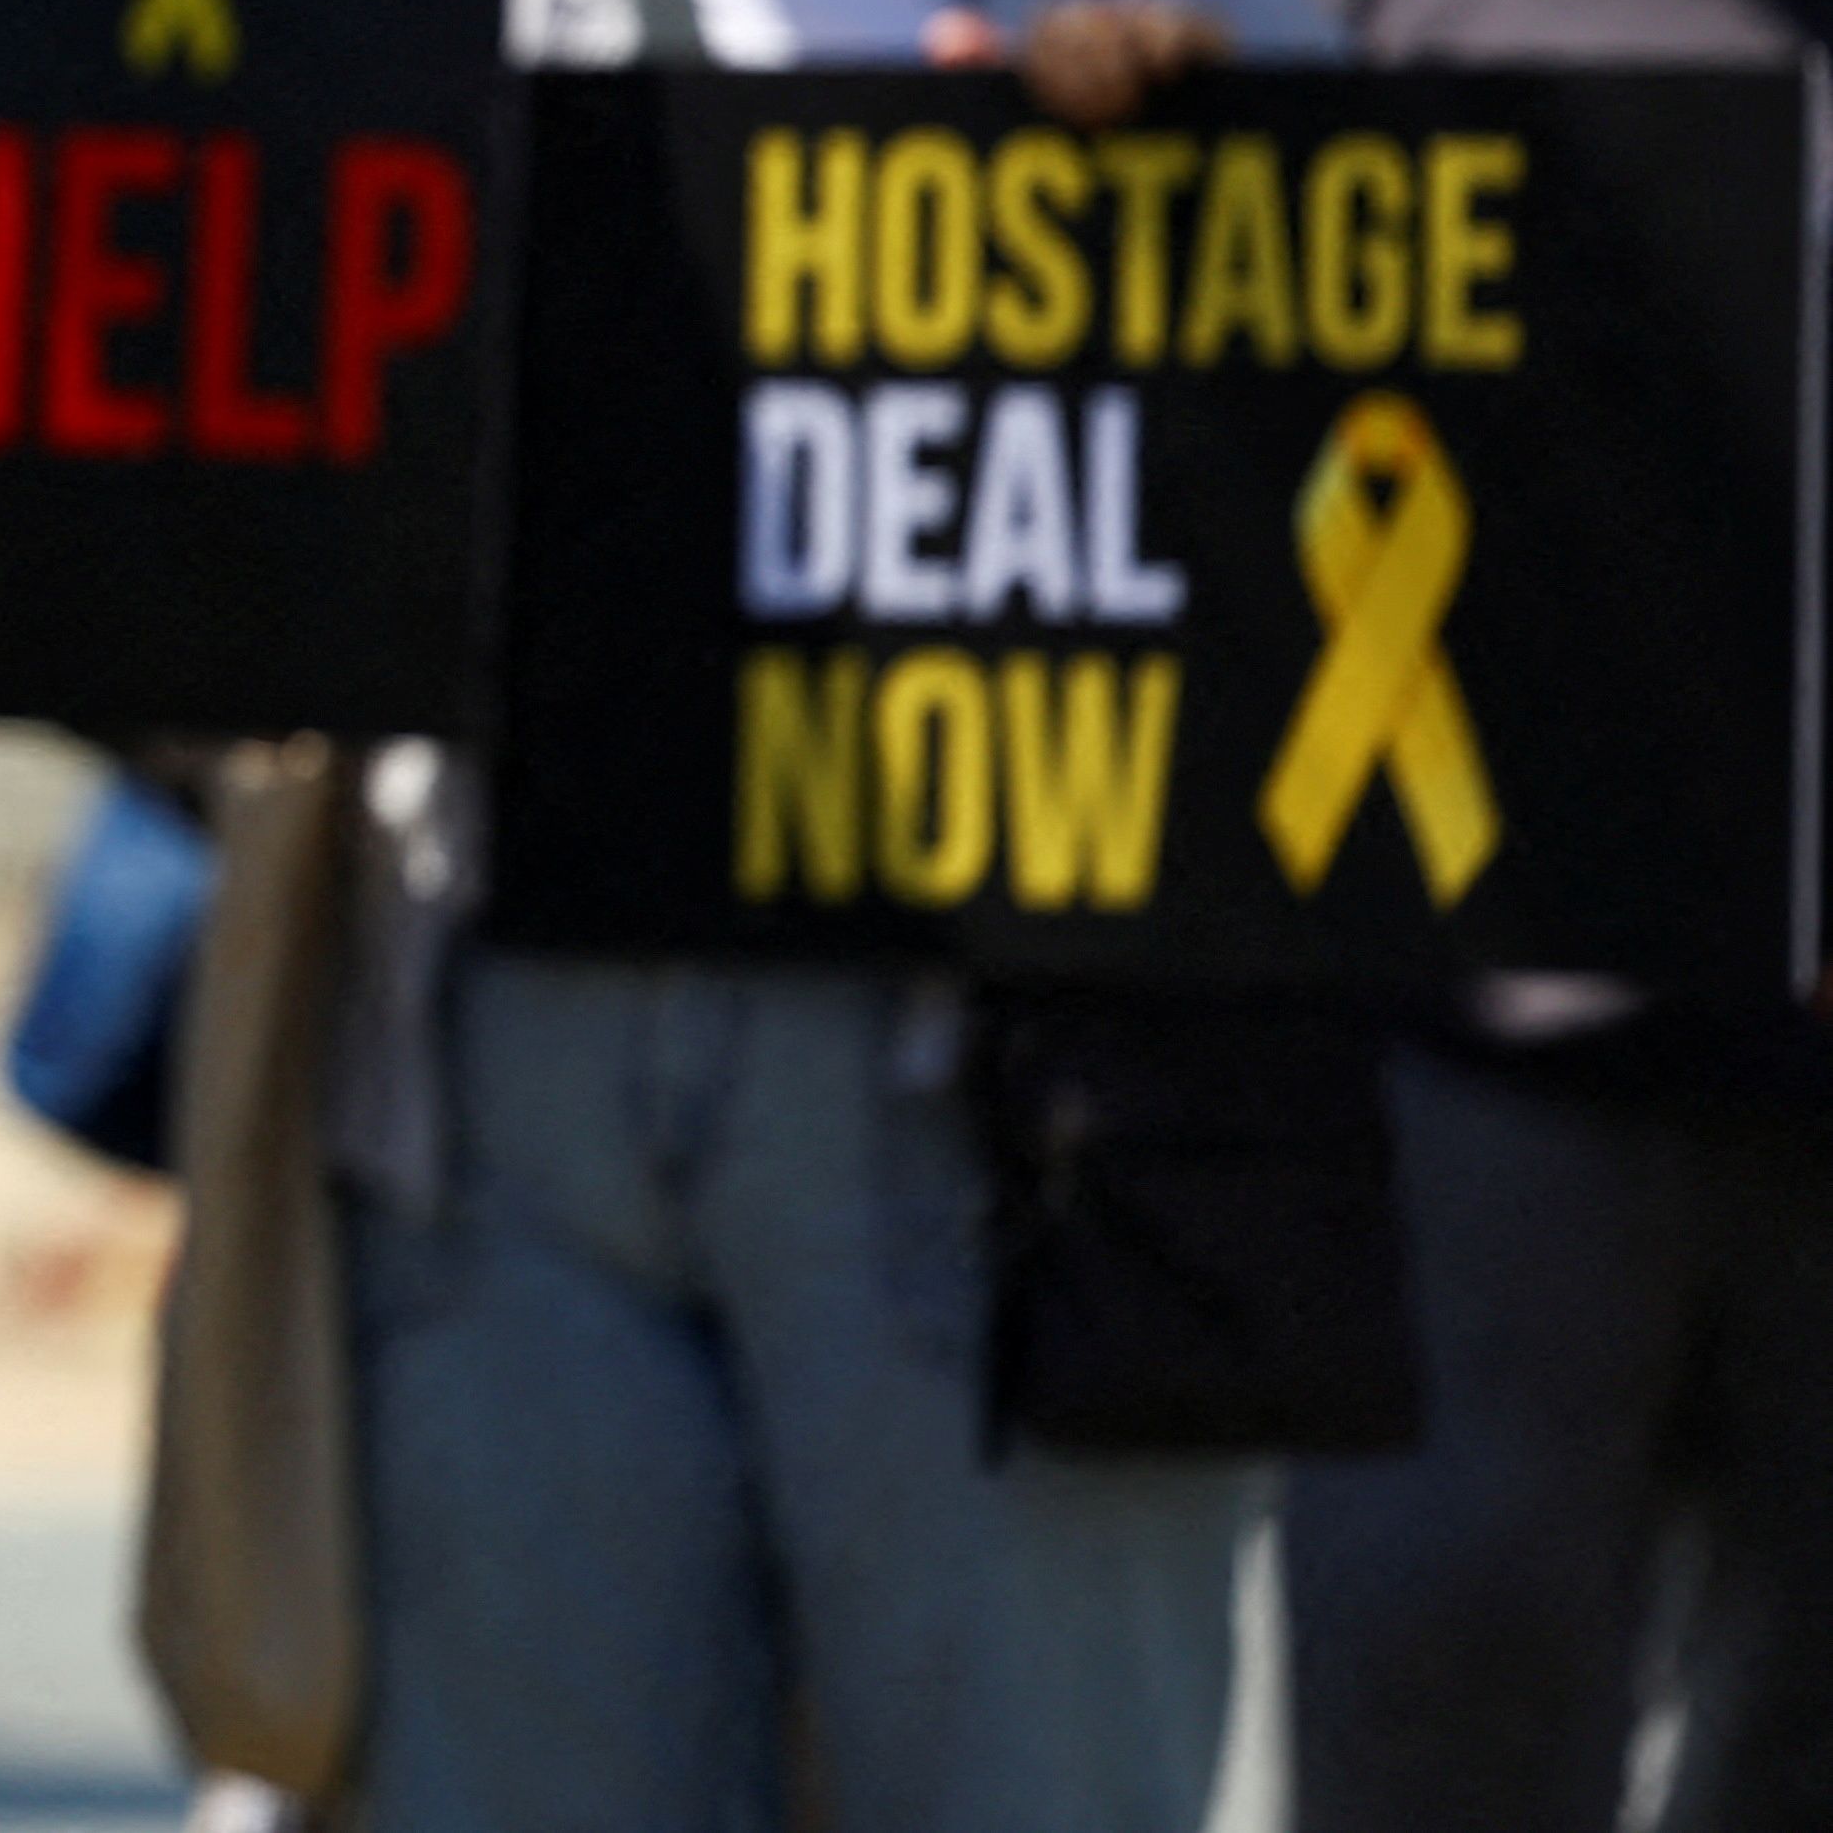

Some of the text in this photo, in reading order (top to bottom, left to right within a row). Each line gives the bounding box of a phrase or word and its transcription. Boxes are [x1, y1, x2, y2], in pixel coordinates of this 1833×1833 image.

[745, 126, 1527, 370] HOSTAGE
[741, 378, 1189, 624] DEAL
[735, 646, 1183, 910] NOW
